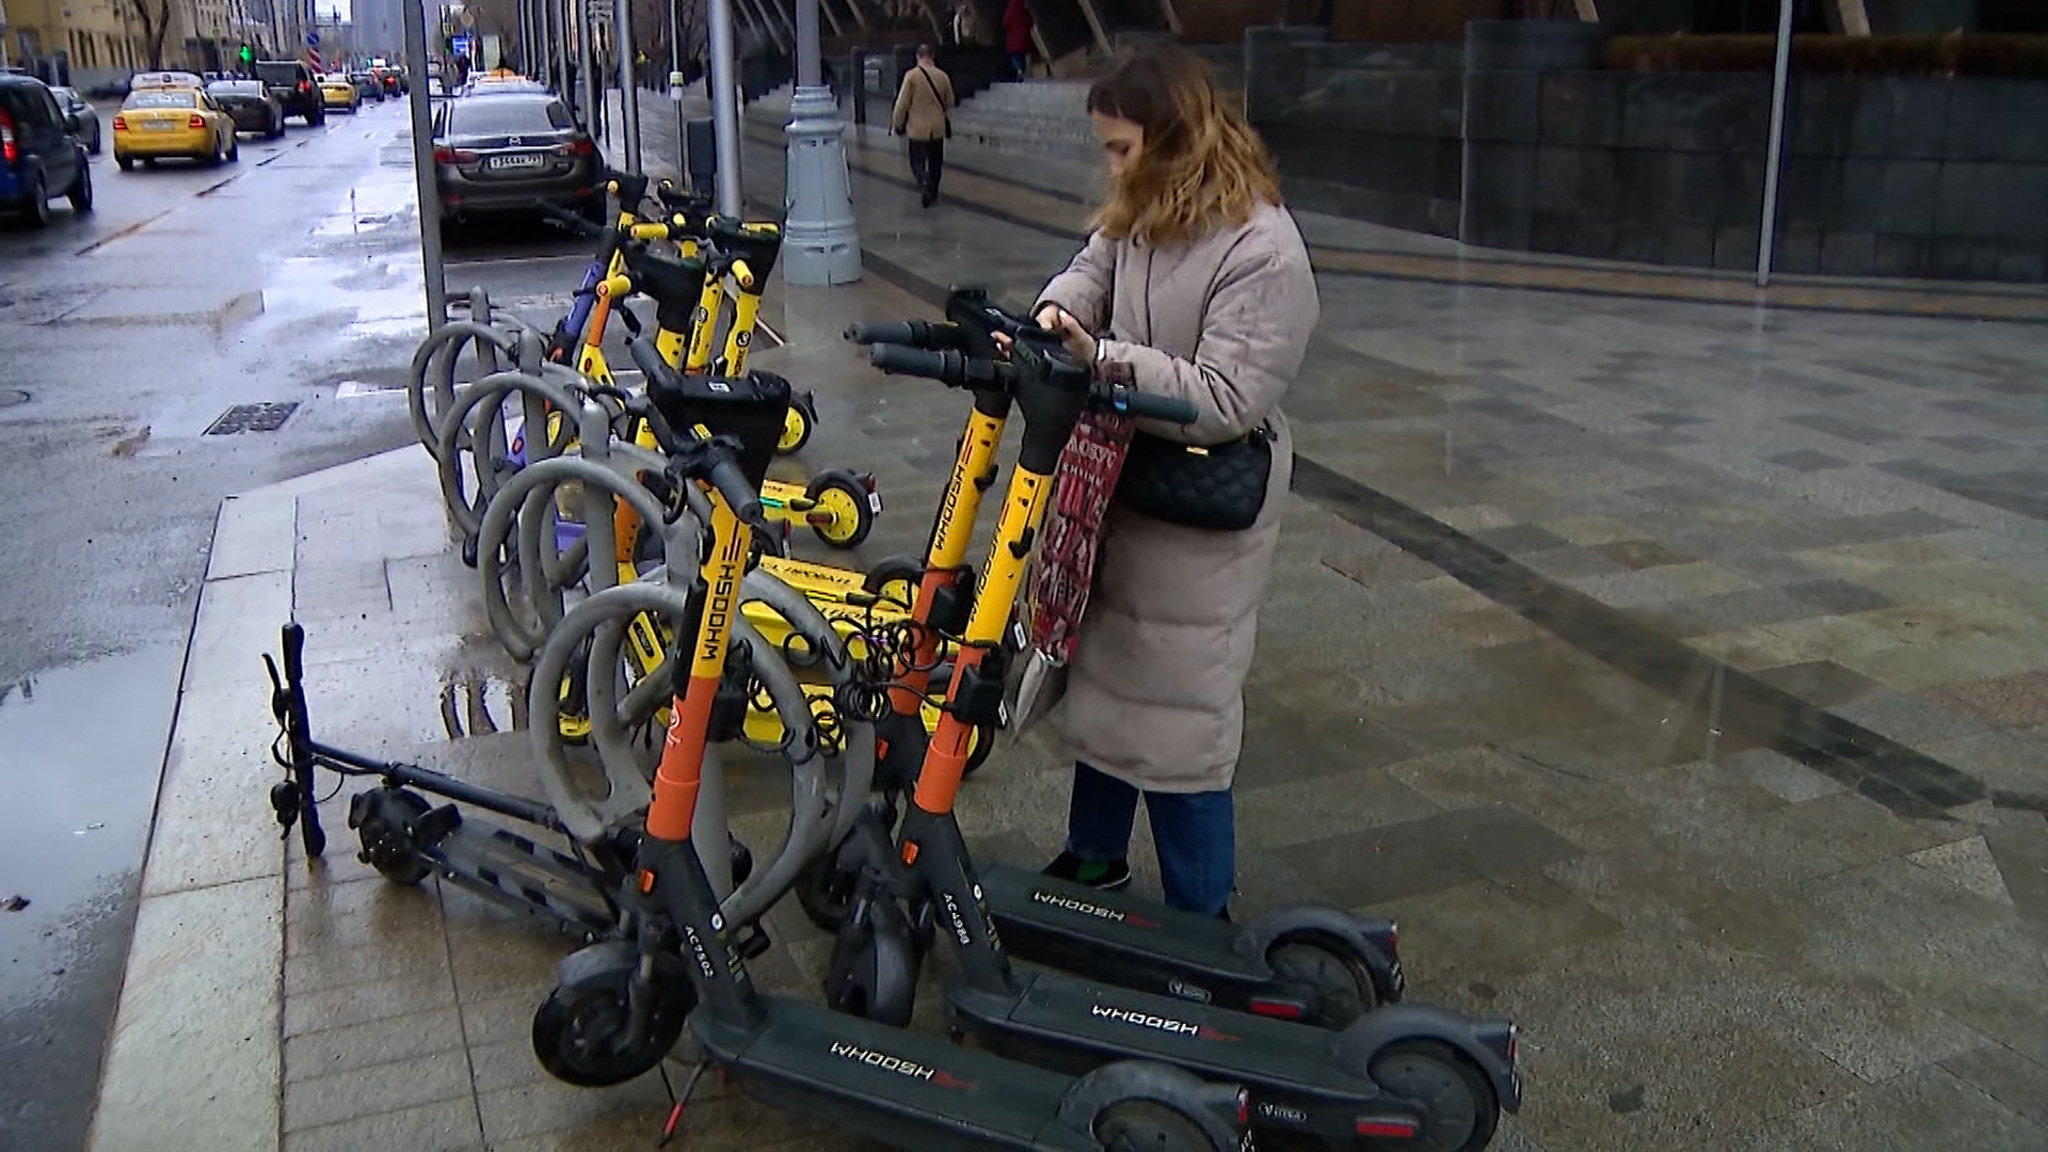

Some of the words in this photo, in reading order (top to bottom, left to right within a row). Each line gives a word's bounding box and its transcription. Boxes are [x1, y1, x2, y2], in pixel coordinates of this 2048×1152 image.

[935, 465, 965, 550] WHOOSH
[701, 564, 736, 660] WHOOSH
[1034, 891, 1125, 921] WHOOSH
[1092, 1004, 1198, 1036] WHOOSH
[830, 1041, 935, 1081] WHOOSH
